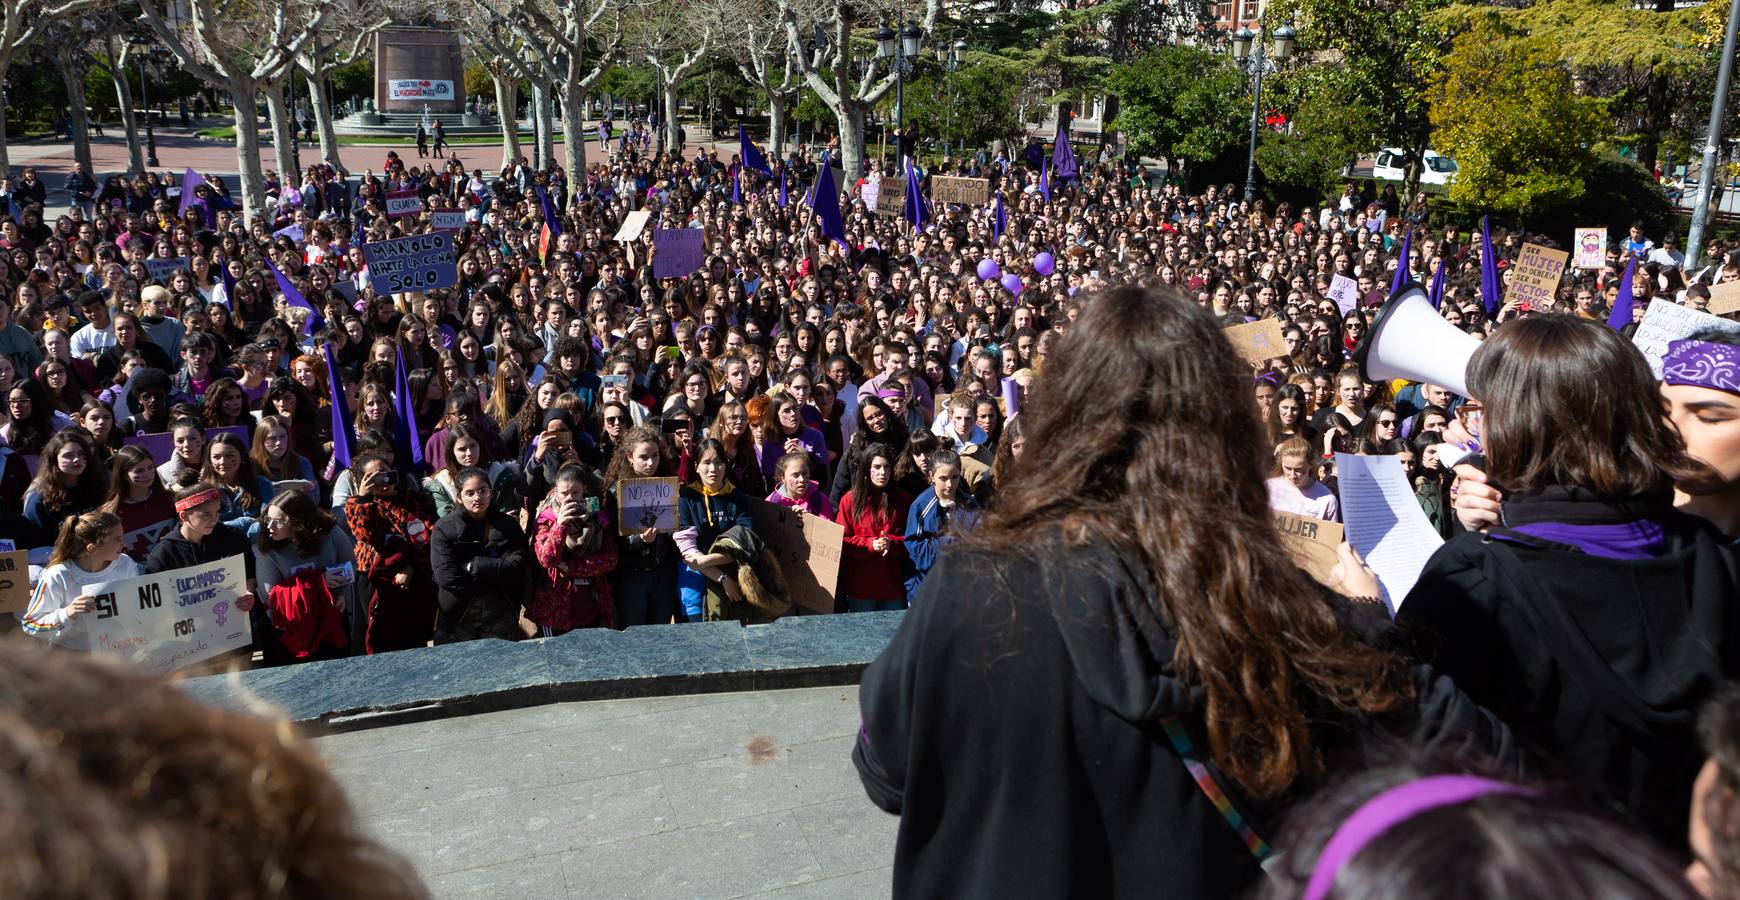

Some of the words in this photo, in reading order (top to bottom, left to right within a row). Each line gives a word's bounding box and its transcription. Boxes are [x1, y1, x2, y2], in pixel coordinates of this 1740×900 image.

[391, 199, 418, 211] GUAPA
[436, 215, 463, 226] NENA
[371, 234, 444, 258] MANOLO
[1526, 246, 1541, 255] SER
[370, 259, 404, 277] HAZTE
[407, 257, 421, 269] LA
[422, 251, 453, 266] CENA
[1521, 254, 1563, 273] MUJER
[389, 270, 438, 292] SOLO
[1516, 274, 1530, 282] SER
[1511, 282, 1550, 299] FACTOR
[1655, 303, 1669, 314] NO
[628, 487, 642, 500] NO
[655, 484, 670, 498] NO
[95, 592, 119, 619] SI
[138, 583, 162, 609] NO
[179, 588, 217, 607] JUNTAS
[173, 618, 196, 637] POR
